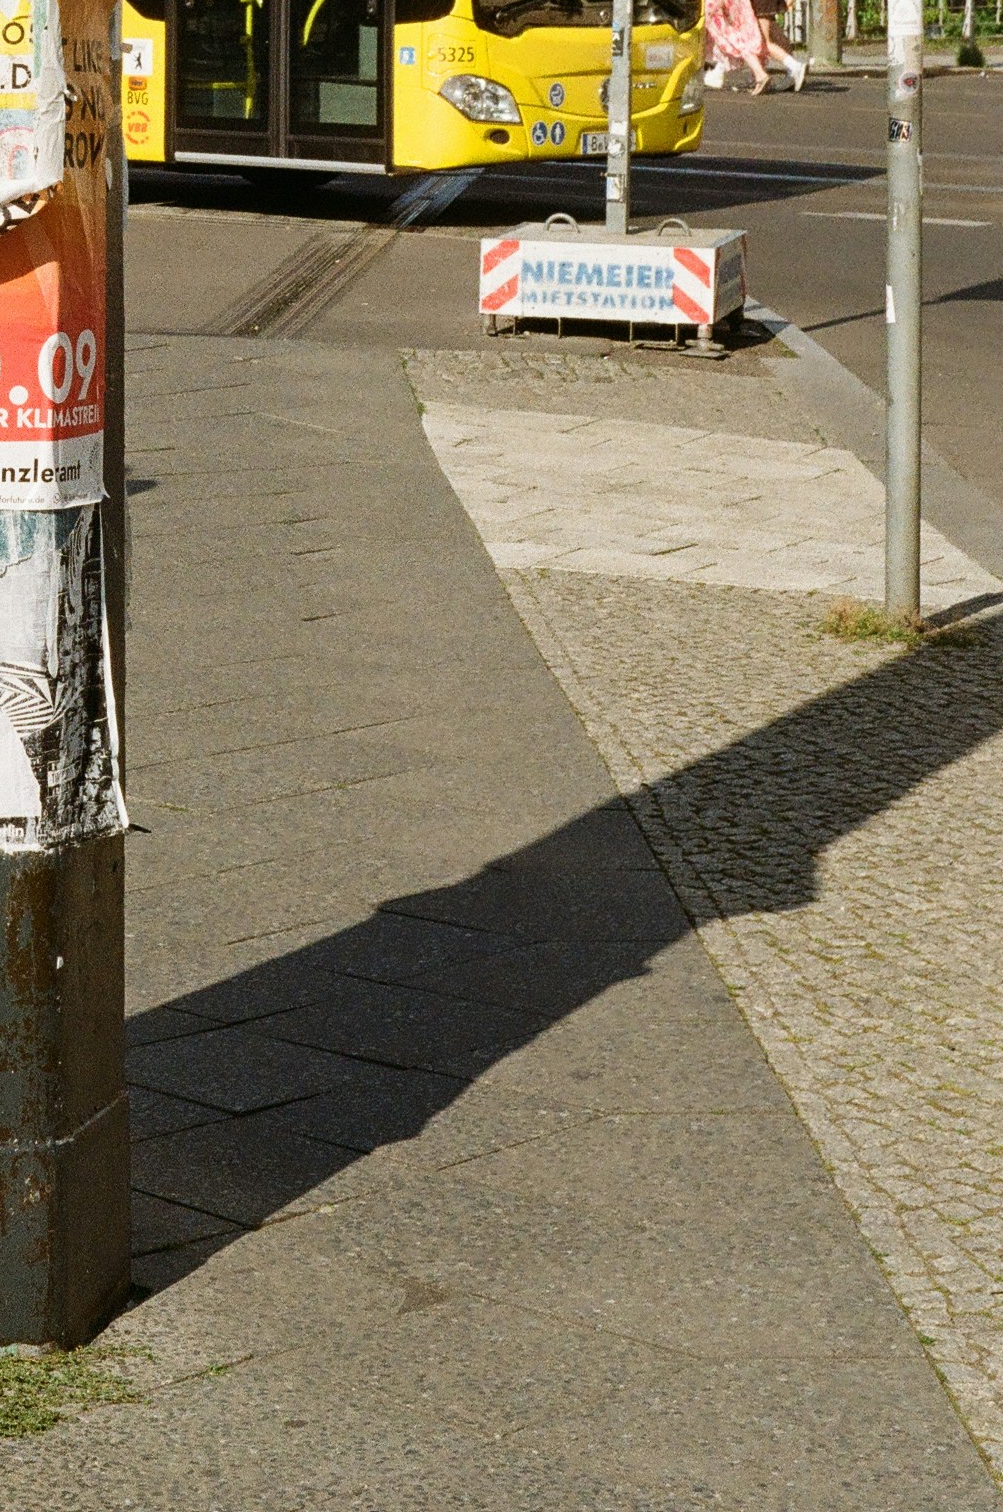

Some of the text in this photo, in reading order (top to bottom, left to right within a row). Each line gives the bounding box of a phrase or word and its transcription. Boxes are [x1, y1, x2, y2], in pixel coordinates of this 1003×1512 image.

[437, 46, 475, 63] 5325
[127, 90, 149, 106] BVG
[128, 122, 148, 133] VBB
